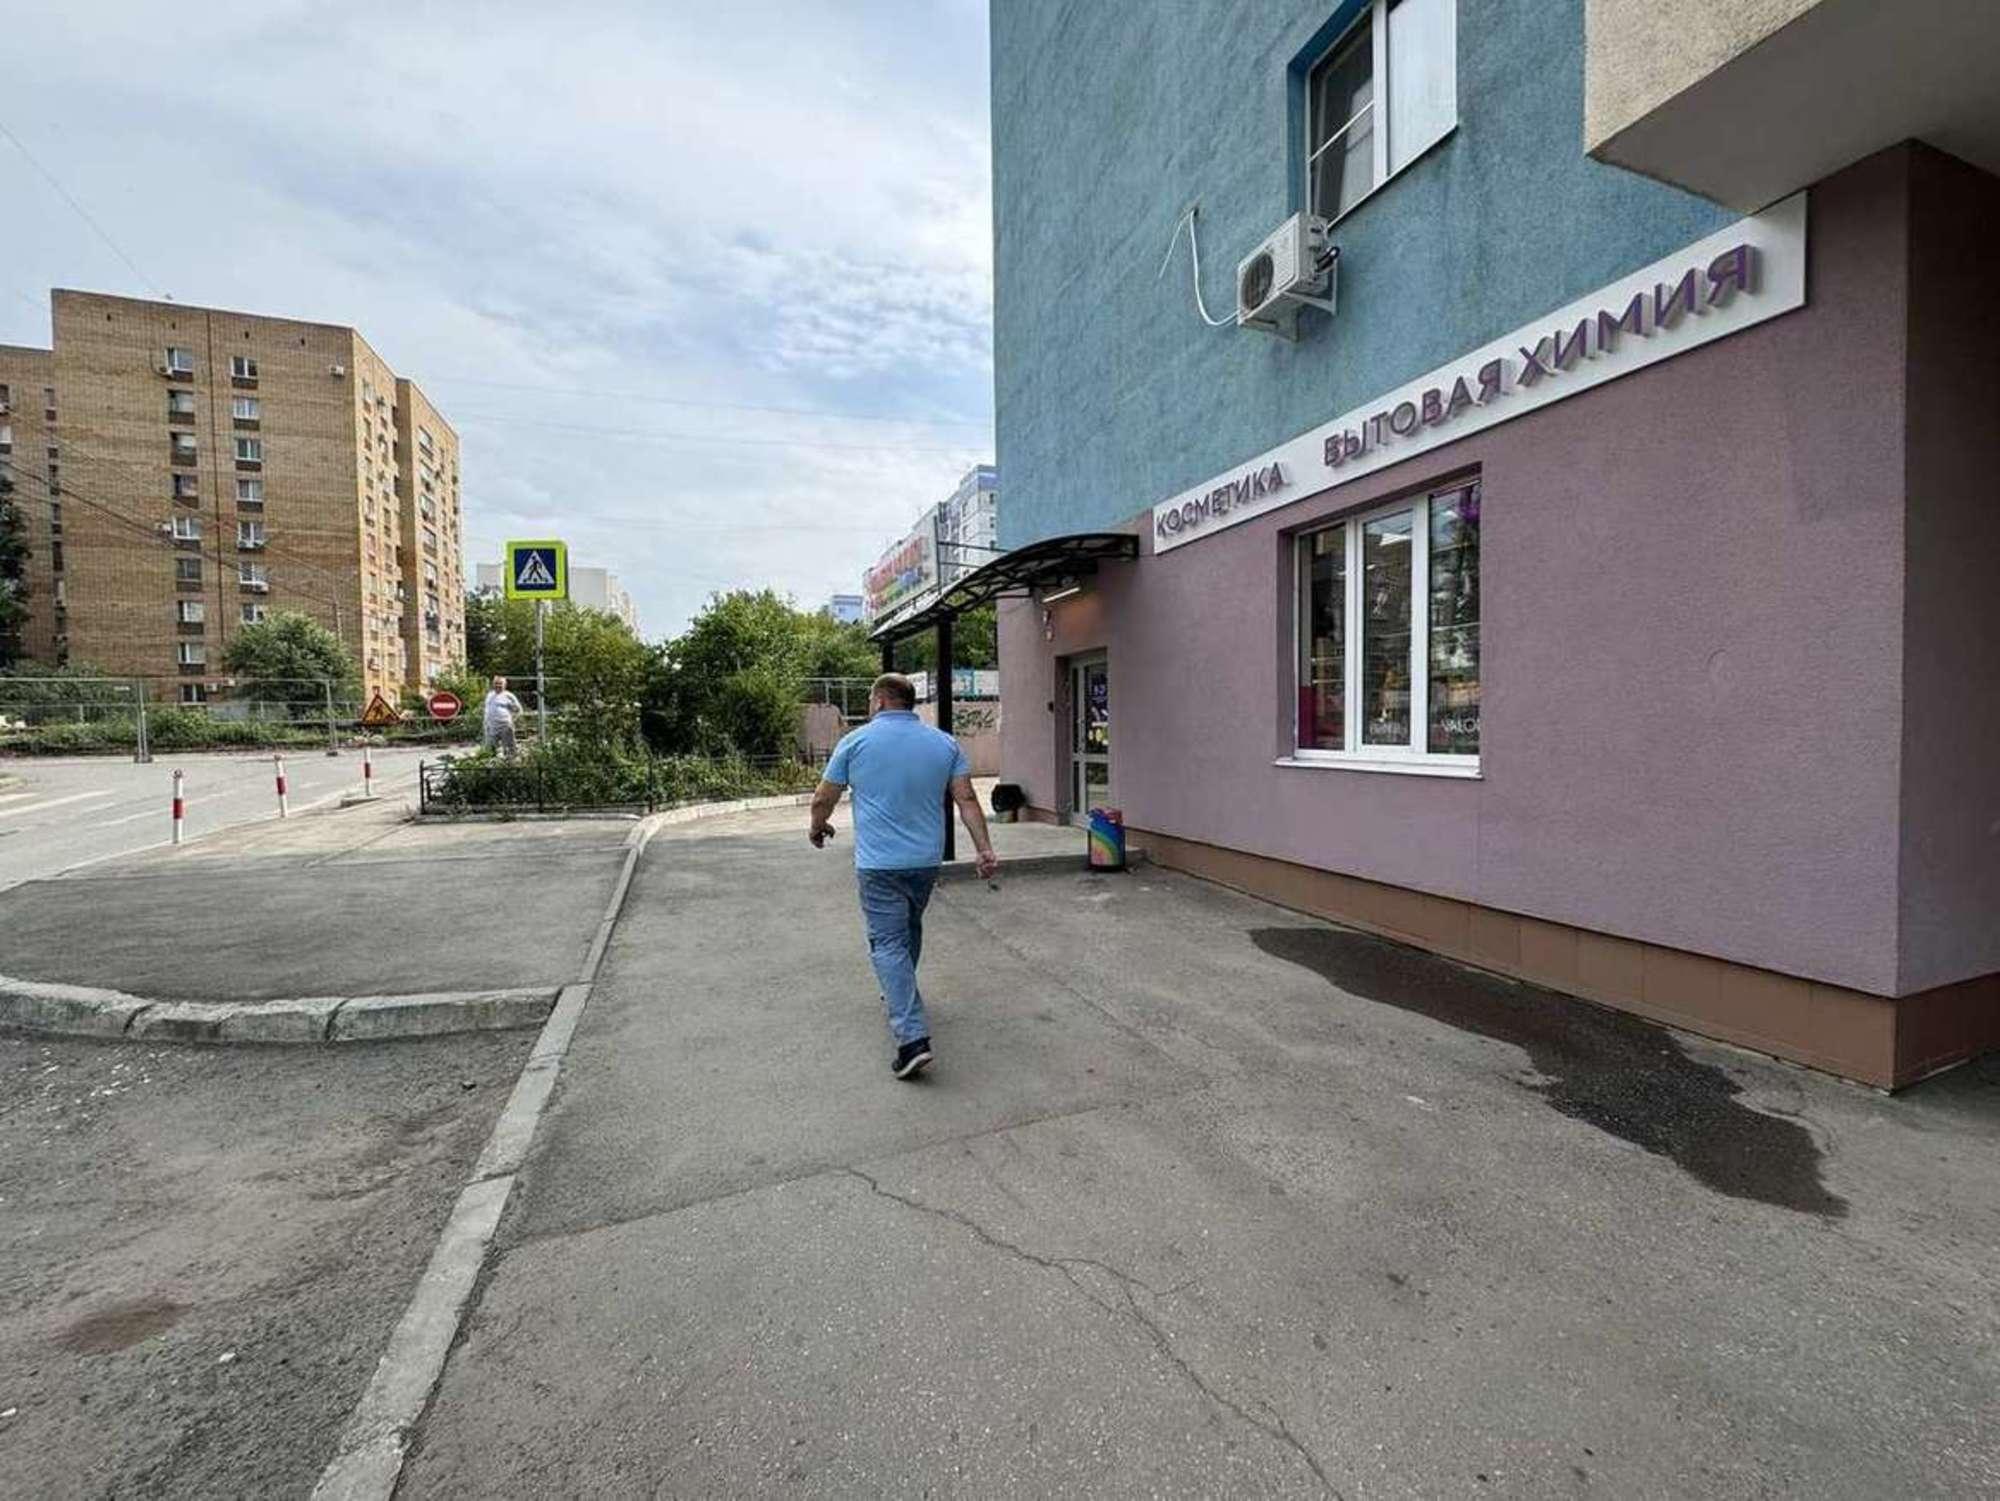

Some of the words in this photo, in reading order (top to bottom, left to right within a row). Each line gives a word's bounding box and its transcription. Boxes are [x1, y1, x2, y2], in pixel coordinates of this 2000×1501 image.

[1155, 461, 1287, 537] КОСМЕТИКА
[1324, 356, 1507, 467] БЫТОВАЯ
[1515, 243, 1757, 386] ХИМИЯ
